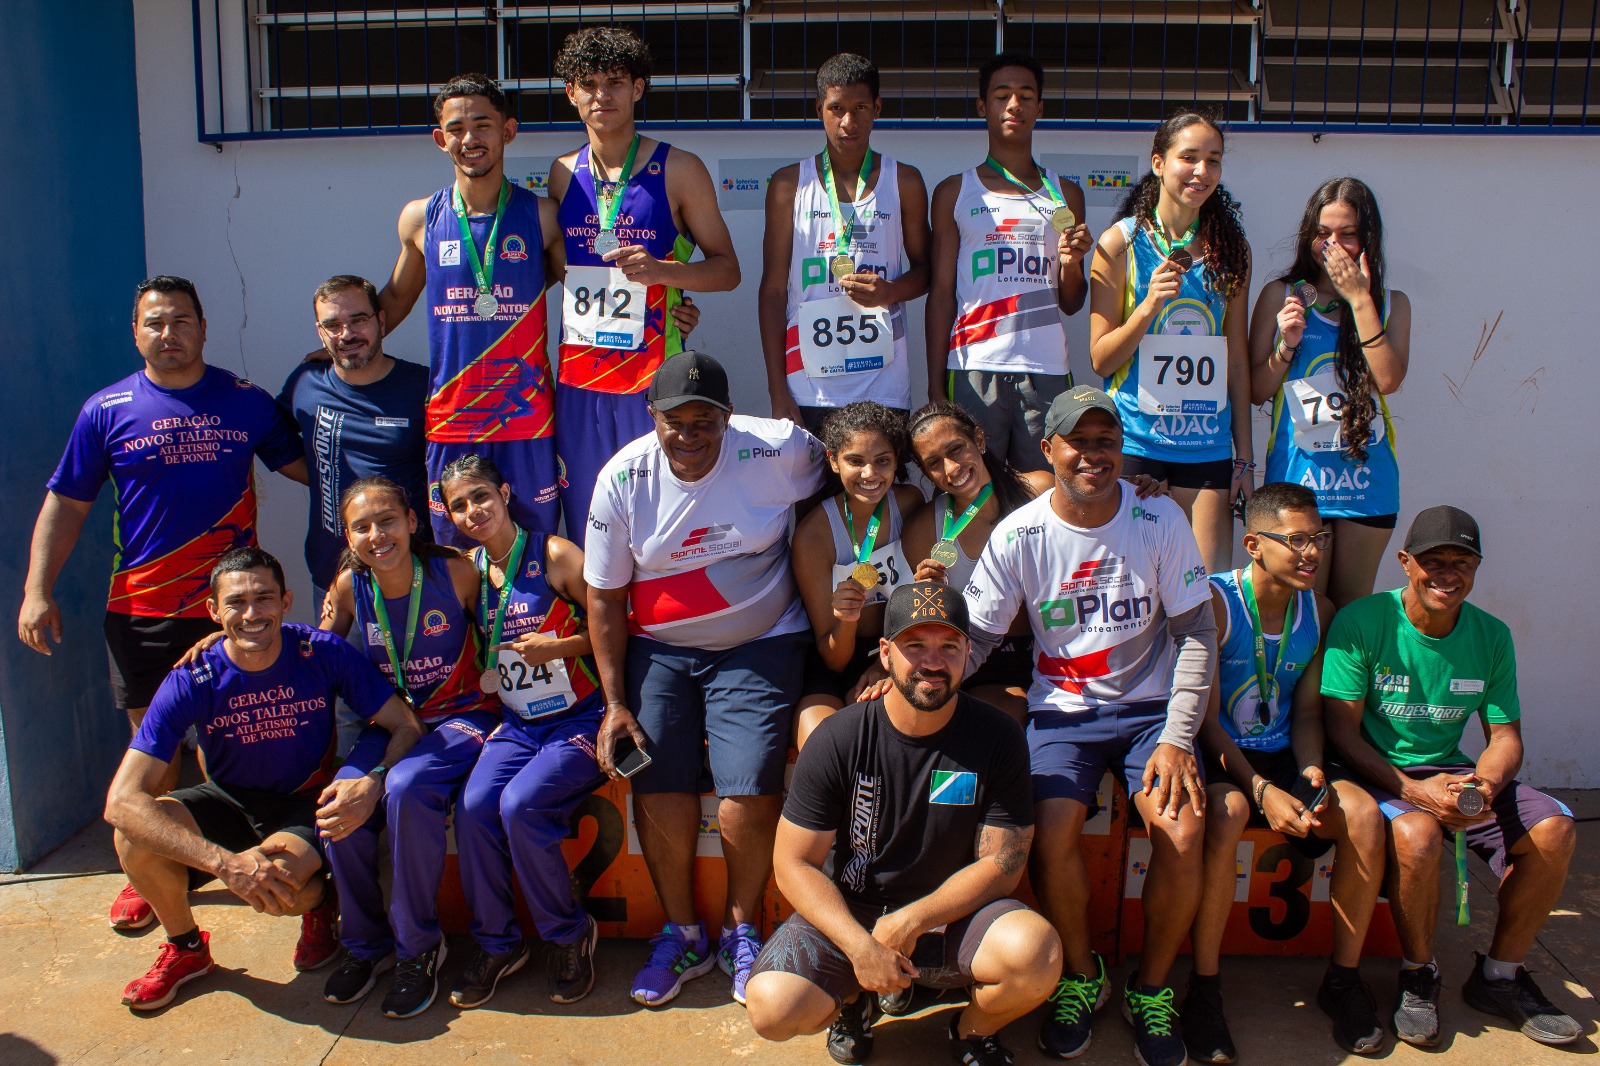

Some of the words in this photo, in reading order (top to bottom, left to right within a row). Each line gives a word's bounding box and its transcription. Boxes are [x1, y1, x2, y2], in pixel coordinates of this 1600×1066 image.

[813, 211, 831, 219] Plan
[873, 211, 890, 220] Plan
[980, 206, 1000, 214] Plan
[566, 227, 597, 238] NOVOS
[985, 233, 1016, 241] Sprint
[997, 247, 1052, 276] Plan
[433, 304, 469, 316] NOVOS
[574, 286, 632, 319] 812
[812, 314, 879, 347] 855
[1153, 355, 1216, 386] 790
[1301, 392, 1345, 426] 79
[152, 413, 221, 431] GERAÇÃO
[1149, 415, 1220, 436] ADAC
[124, 432, 174, 453] NOVOS
[176, 429, 249, 443] TALENTOS
[159, 441, 221, 456] ATLETISMO
[164, 455, 180, 465] DE
[181, 452, 218, 463] PONTA
[752, 448, 780, 458] Plan
[316, 406, 335, 534] FUNDESPORTE
[629, 468, 652, 479] Plan
[1299, 466, 1371, 491] ADAC
[1016, 525, 1045, 538] Plan
[671, 547, 707, 560] Sprint
[708, 540, 742, 552] Social
[1061, 579, 1097, 591] Sprint
[1099, 573, 1132, 585] Social
[1076, 592, 1151, 625] Plan
[1080, 616, 1151, 633] Loteamentos
[498, 661, 553, 692] 824
[229, 685, 295, 709] GERAÇÃO
[252, 697, 326, 721] TALENTOS
[1378, 702, 1466, 719] FUNDESPORTE
[236, 717, 298, 736] ATLETISMO
[241, 734, 258, 744] DE
[260, 728, 297, 740] PONTA
[563, 794, 627, 922] 2
[1248, 843, 1315, 941] 3
